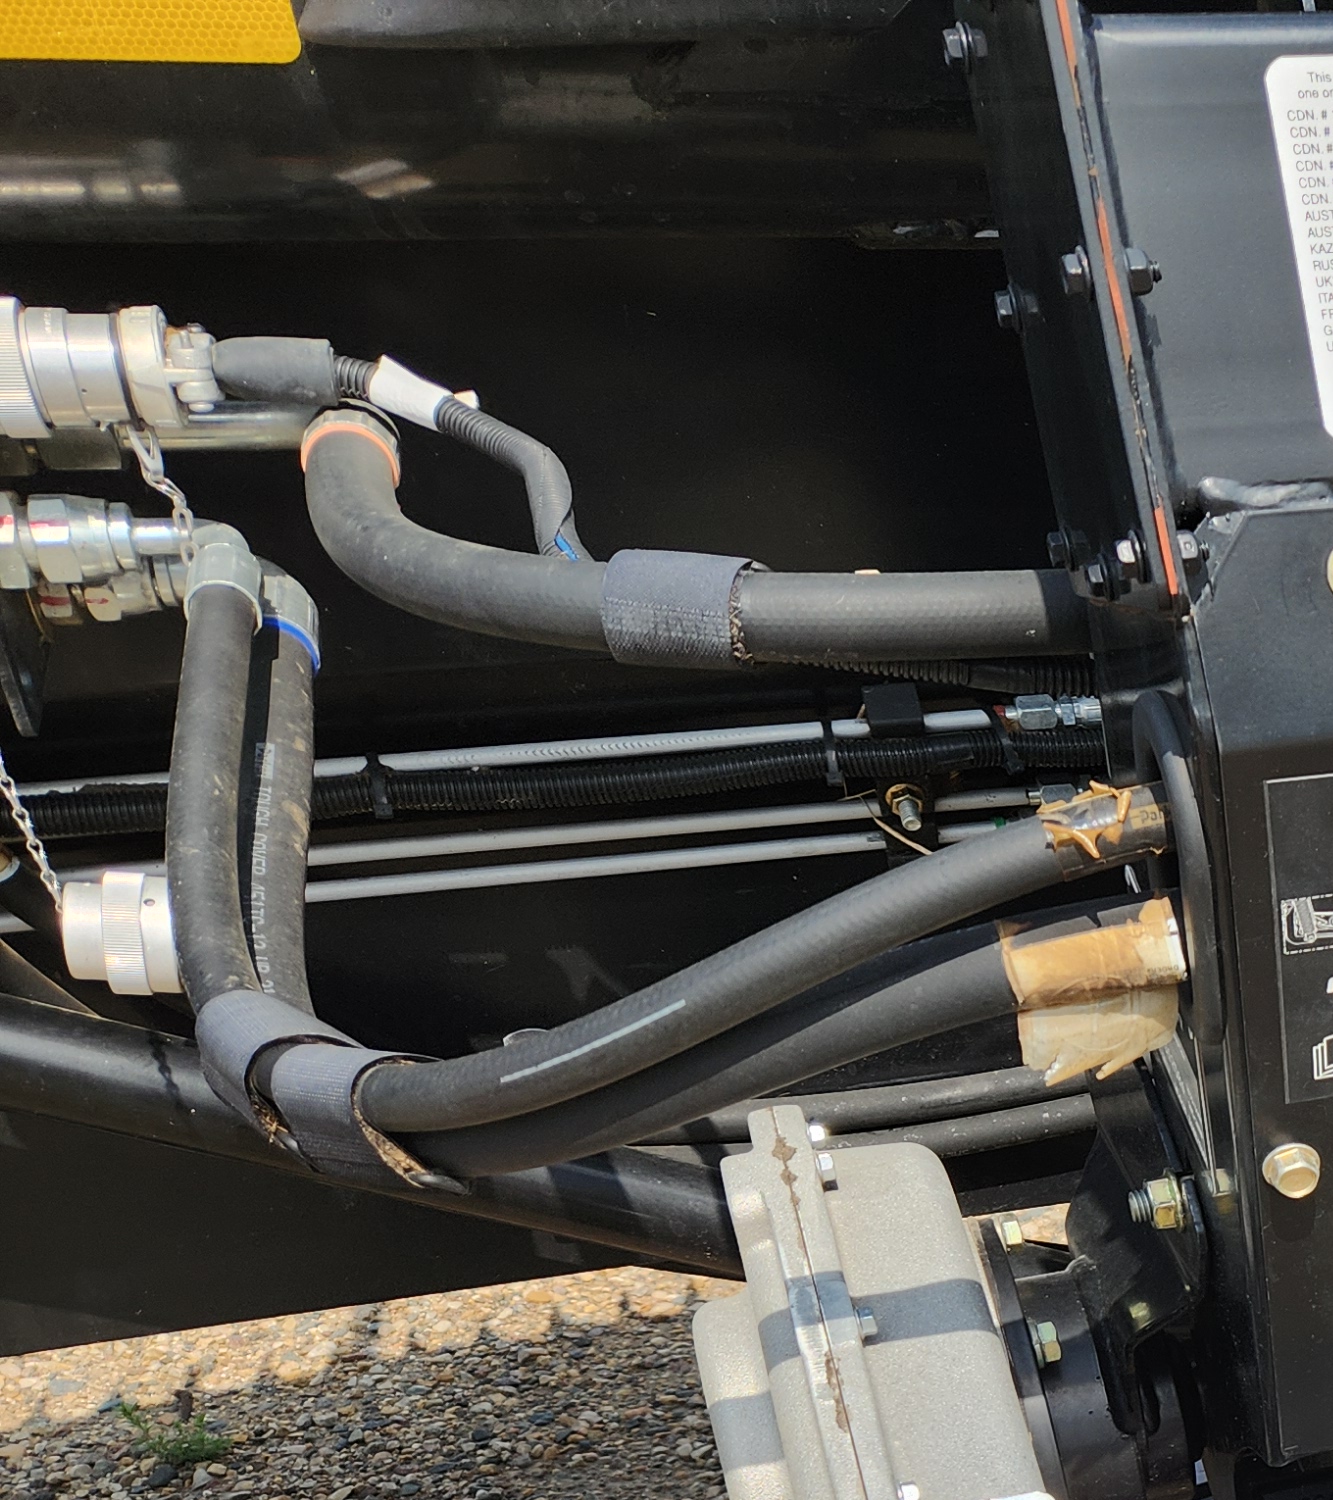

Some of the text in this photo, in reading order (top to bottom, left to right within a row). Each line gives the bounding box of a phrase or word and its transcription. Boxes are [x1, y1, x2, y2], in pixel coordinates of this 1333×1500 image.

[1306, 71, 1332, 82] This
[1297, 89, 1319, 99] one
[1322, 88, 1333, 98] or
[1286, 109, 1318, 121] CDN.
[1320, 109, 1327, 119] #
[1289, 125, 1320, 138] CDN.
[1323, 126, 1330, 136] #
[1292, 143, 1323, 155] CDN.
[1326, 143, 1333, 153] #
[255, 786, 273, 826] TOUGH
